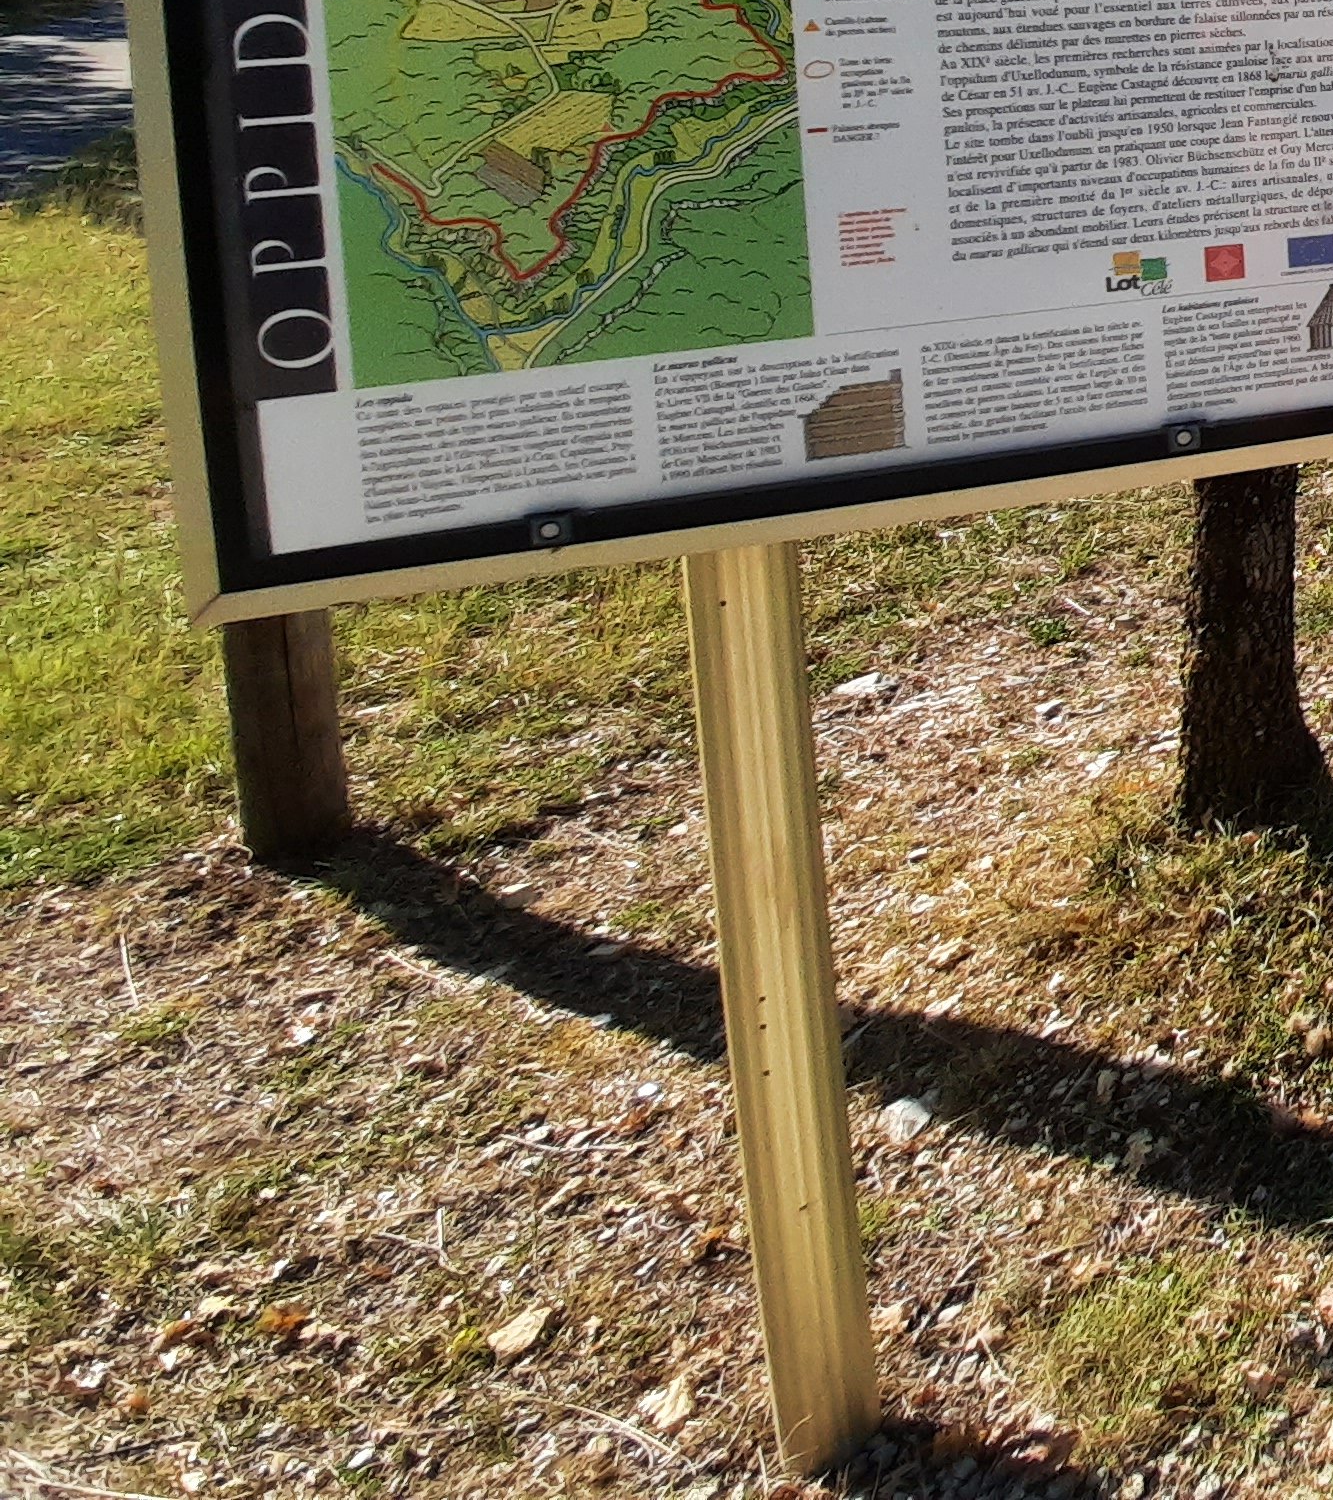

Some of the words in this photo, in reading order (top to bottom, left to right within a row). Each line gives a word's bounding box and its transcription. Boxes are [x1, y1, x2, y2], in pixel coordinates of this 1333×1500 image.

[935, 10, 952, 21] est
[1031, 5, 1058, 16] voué
[1064, 6, 1090, 17] pour
[1094, 0, 1151, 13] l'essentiel
[1156, 2, 1175, 10] aux
[941, 90, 954, 102] de
[993, 90, 1006, 98] en
[1009, 86, 1022, 97] 51
[1078, 80, 1117, 95] Eugène
[1222, 75, 1234, 83] en
[1238, 70, 1261, 82] 1868
[944, 138, 960, 149] Le
[964, 136, 984, 148] site
[989, 133, 1023, 146] tombe
[1027, 131, 1054, 143] dans
[1058, 128, 1093, 141] l'oubli
[1098, 124, 1143, 140] jusqu'en
[1148, 122, 1173, 134] 1950
[1177, 119, 1216, 134] lorsque
[1220, 117, 1243, 129] Jean
[946, 169, 973, 181] n'est
[1034, 162, 1058, 177] qu'à
[1061, 159, 1092, 175] partir
[1095, 158, 1108, 169] de
[1145, 152, 1183, 165] Olivier
[1267, 145, 1277, 155] et
[1280, 143, 1301, 156] Guy
[1106, 275, 1140, 292] Lot
